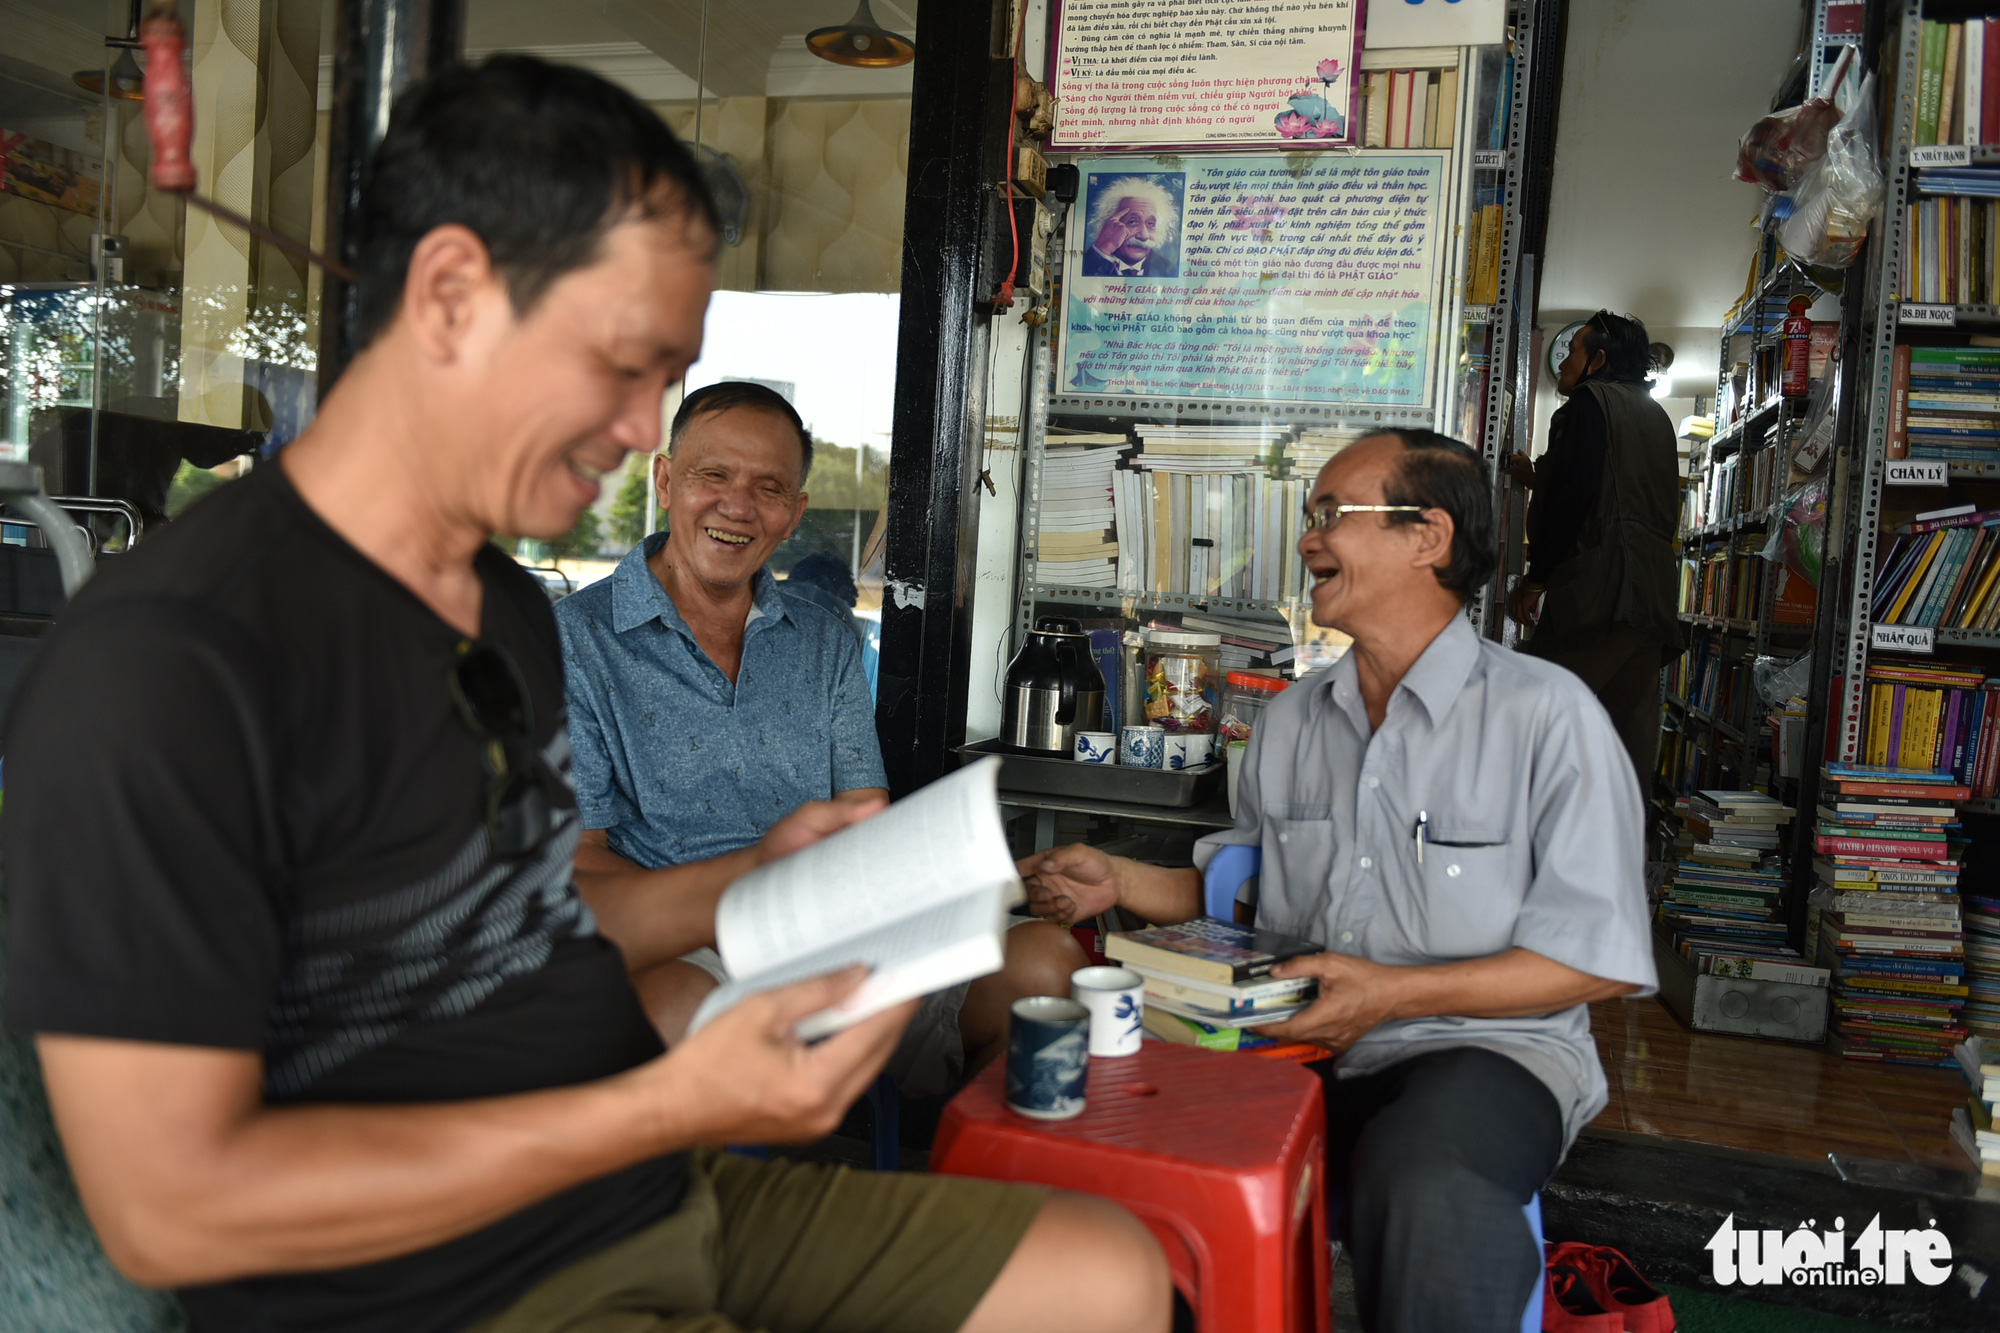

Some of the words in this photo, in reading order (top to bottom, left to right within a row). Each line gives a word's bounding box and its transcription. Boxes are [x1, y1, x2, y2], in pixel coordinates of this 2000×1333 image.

[1944, 151, 1965, 162] HẠNH
[1226, 169, 1246, 178] giáo
[1250, 168, 1266, 176] của
[1315, 168, 1326, 176] sẽ
[1329, 168, 1337, 176] là
[1341, 168, 1361, 178] một
[1363, 168, 1379, 176] tôn
[1382, 167, 1404, 178] giáo
[1407, 168, 1429, 176] toàn
[1930, 310, 1952, 321] NGỌC
[1890, 466, 1924, 479] CHÂN
[1928, 465, 1943, 479] LÝ
[1876, 632, 1905, 643] NHÂN
[1907, 633, 1928, 646] QUẢ
